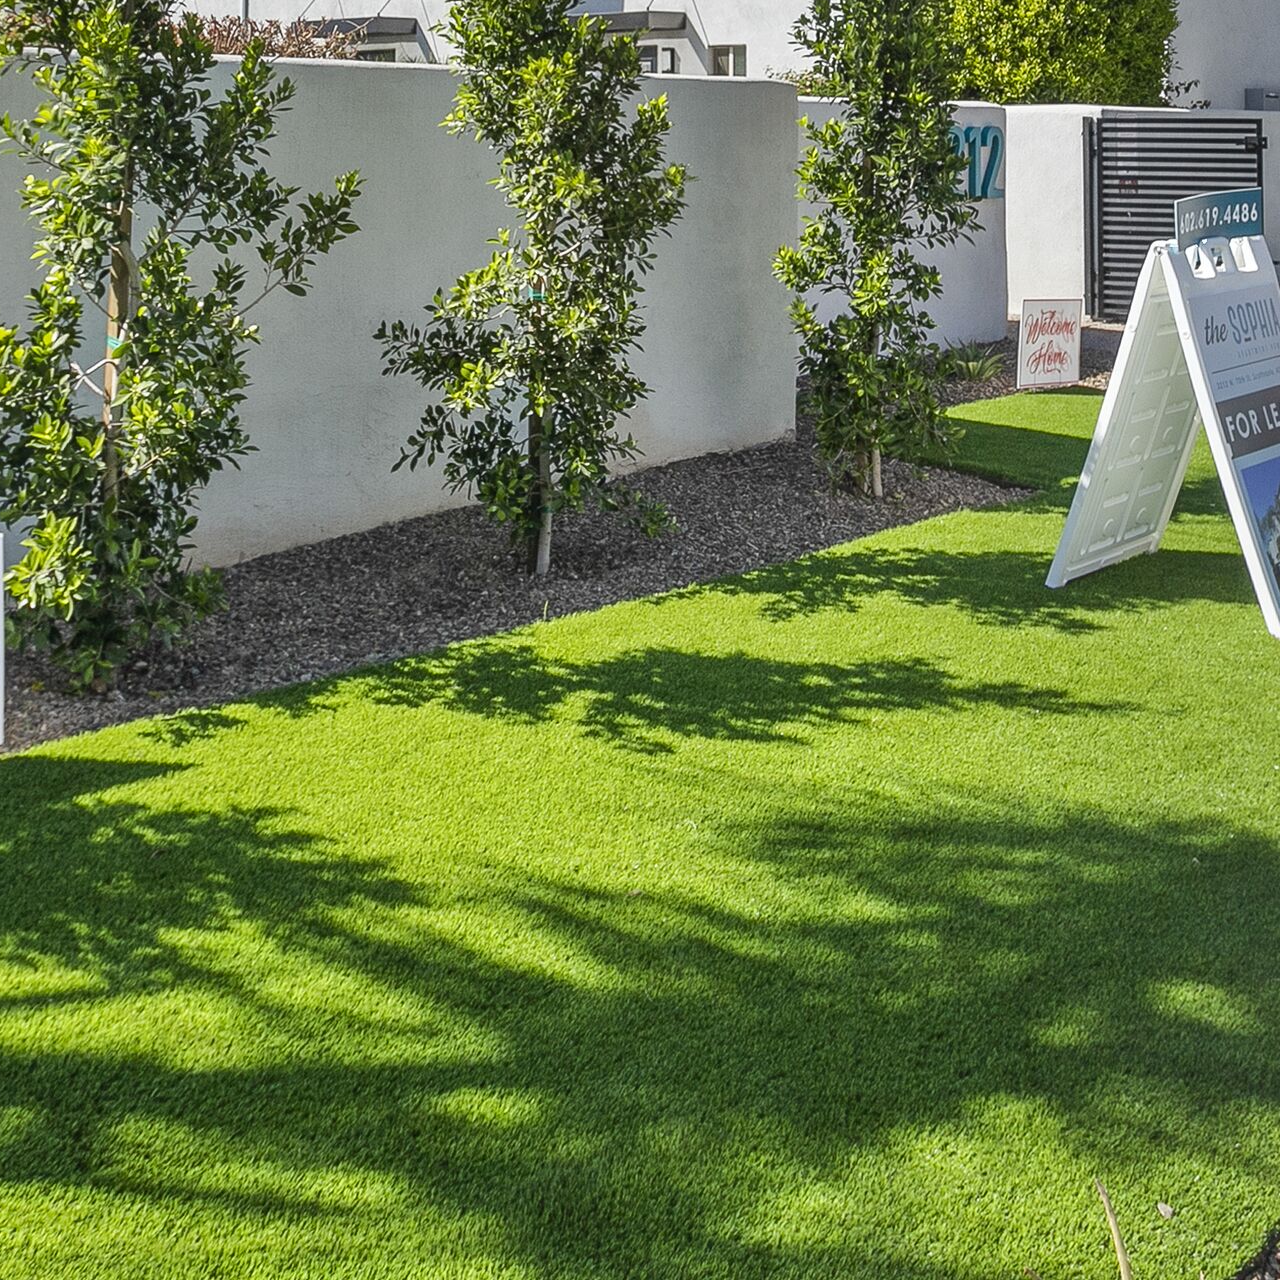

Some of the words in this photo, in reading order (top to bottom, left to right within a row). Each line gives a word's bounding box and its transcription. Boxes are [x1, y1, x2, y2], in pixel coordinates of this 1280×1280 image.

[1180, 202, 1258, 235] 602.619.4486
[1024, 307, 1077, 345] Welcome
[1204, 315, 1229, 346] the
[1026, 340, 1071, 375] Home
[1225, 410, 1262, 442] FOR
